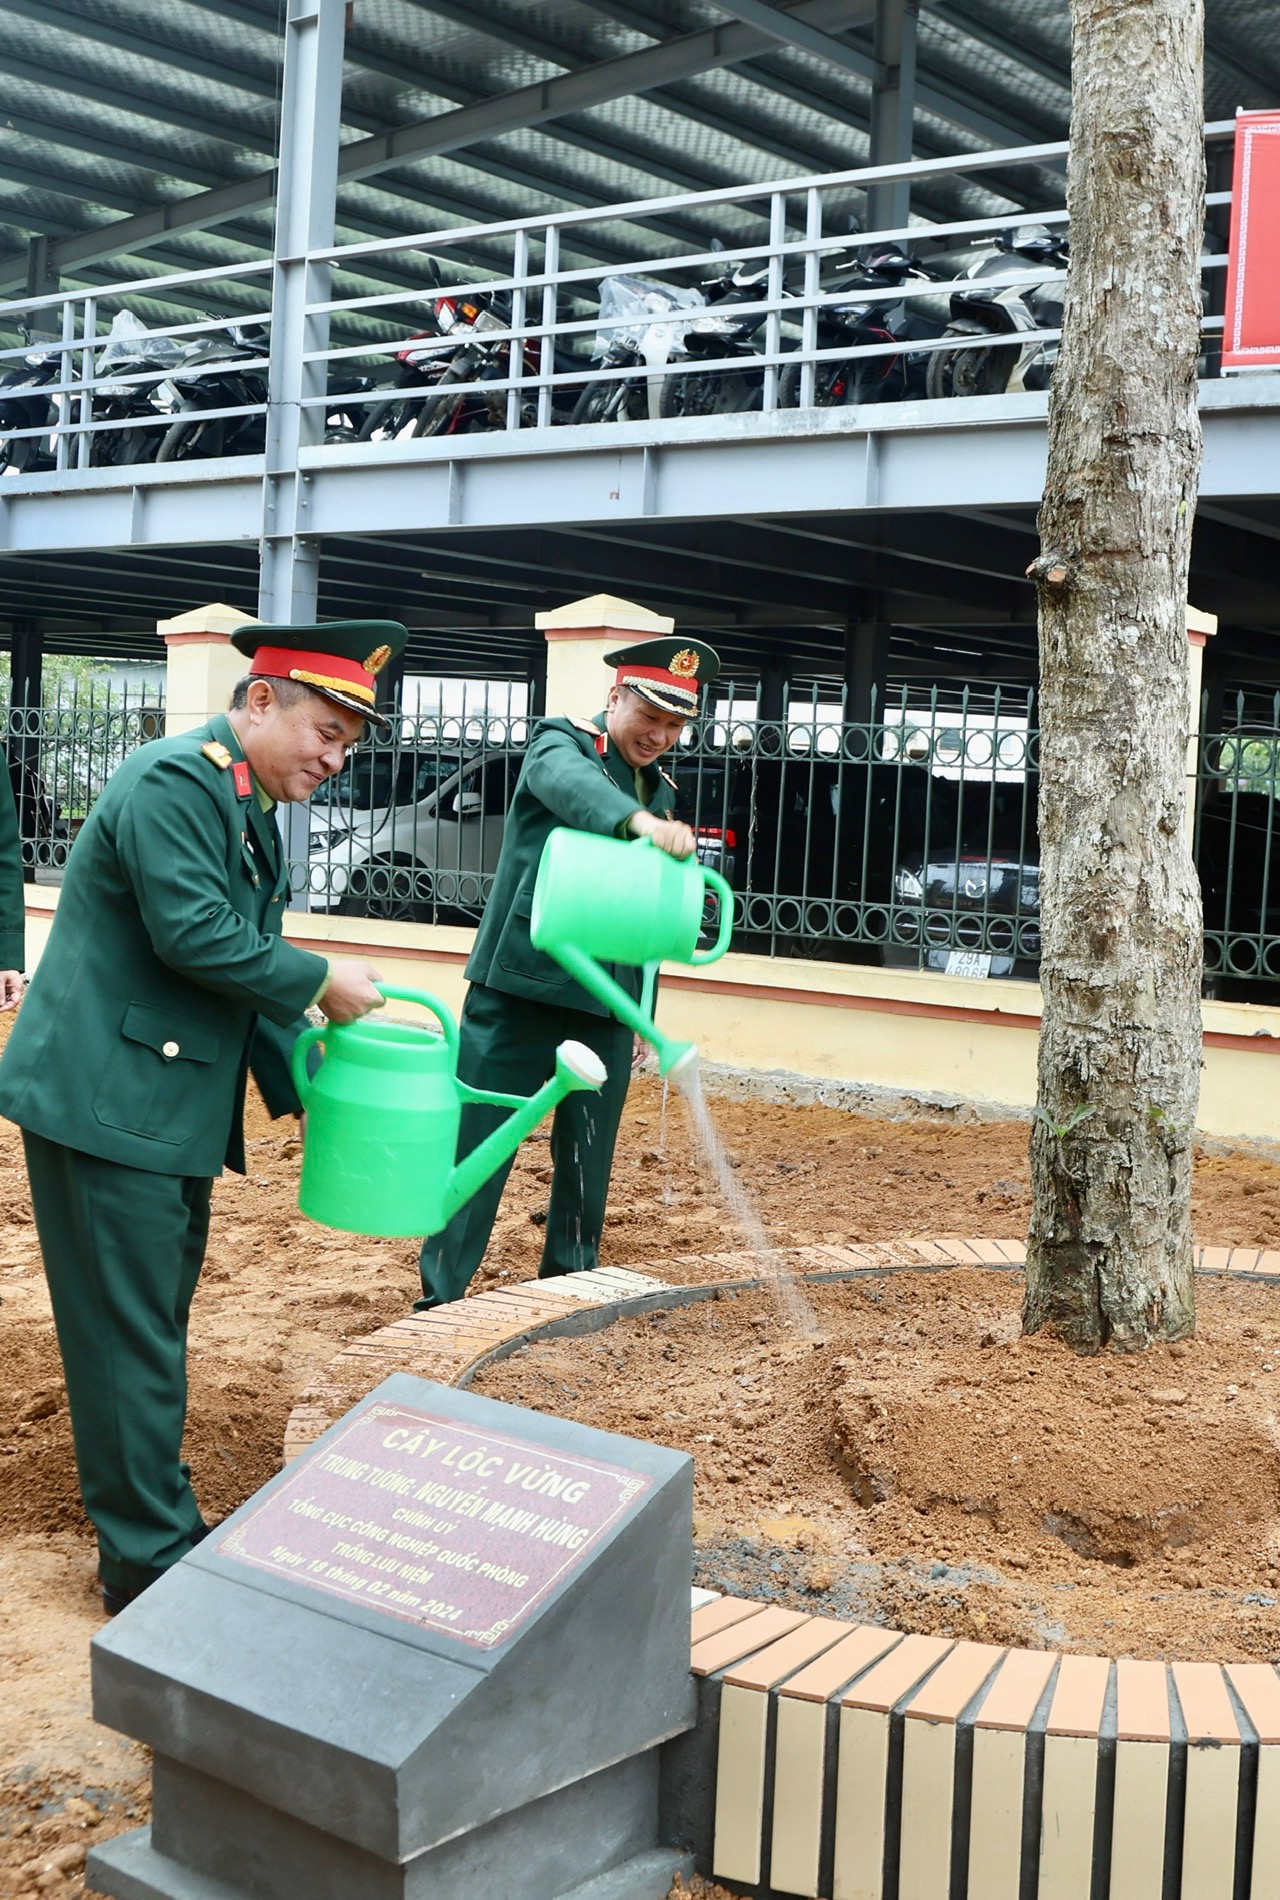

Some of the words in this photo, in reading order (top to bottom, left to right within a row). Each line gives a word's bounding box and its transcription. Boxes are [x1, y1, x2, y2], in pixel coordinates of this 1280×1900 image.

[382, 1428, 448, 1459] CÂY
[440, 1446, 504, 1477] LỘC
[504, 1462, 591, 1503] VỪNG
[318, 1453, 370, 1480] TRUNG
[411, 1480, 490, 1518] NGUYỄN
[479, 1501, 541, 1534] MẠNH
[530, 1516, 590, 1549] HÙNG
[391, 1507, 437, 1530] CHÍNH
[287, 1496, 325, 1520] TỔNG
[321, 1511, 353, 1529] CỤC
[349, 1520, 390, 1542] CÔNG
[386, 1532, 440, 1559] NGHIỆP
[436, 1550, 480, 1571] QUỐC
[476, 1562, 530, 1588] PHÒNG
[370, 1555, 402, 1573] LƯU
[396, 1564, 434, 1585] NIỆM
[306, 1559, 329, 1573] 18
[324, 1566, 369, 1590] tháng
[366, 1581, 391, 1596] 02
[386, 1590, 422, 1607] năm
[419, 1600, 464, 1621] 2024
